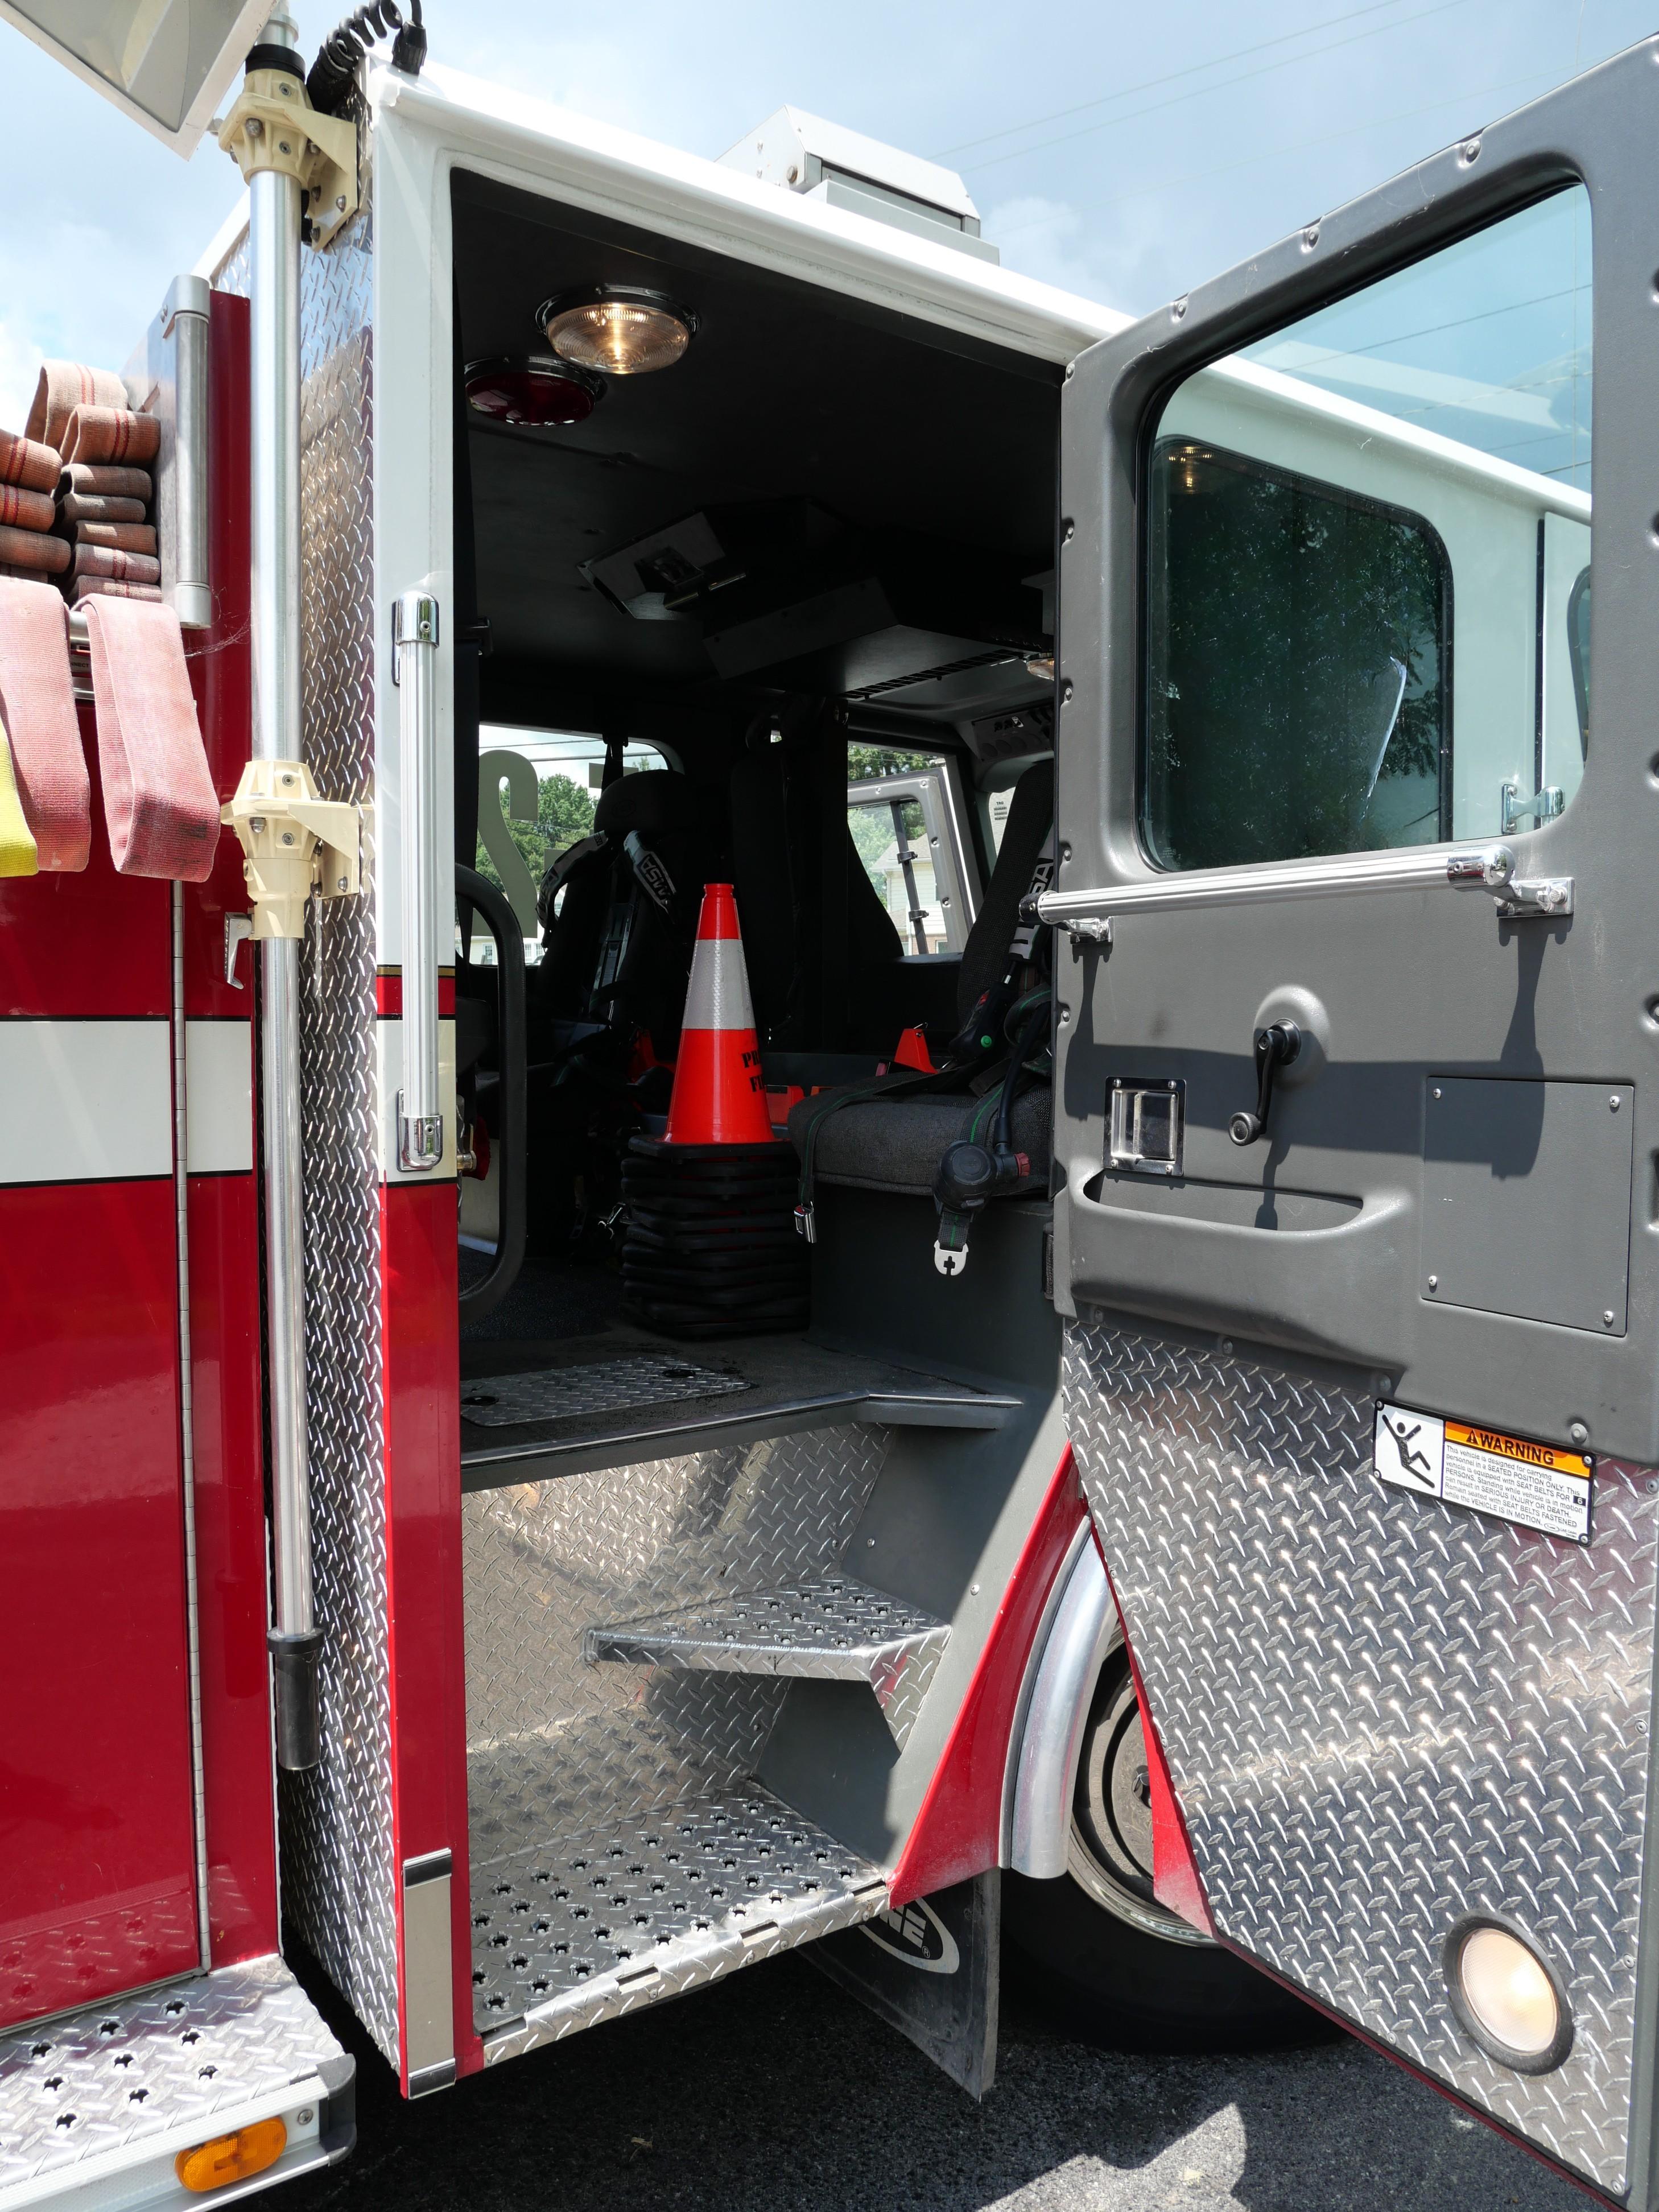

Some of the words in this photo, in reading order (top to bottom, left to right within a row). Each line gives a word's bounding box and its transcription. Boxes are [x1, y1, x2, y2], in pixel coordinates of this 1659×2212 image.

[639, 855, 670, 902] MSA
[742, 1049, 761, 1068] PR
[1459, 1450, 1479, 1459] vehicle
[1488, 1456, 1515, 1469] designed
[1526, 1468, 1551, 1480] carrying
[1480, 1433, 1554, 1465] WARNING
[1446, 1454, 1474, 1466] personnel
[1487, 1464, 1511, 1476] SEATED
[1513, 1472, 1544, 1485] POSITION
[1567, 1487, 1580, 1496] This
[1446, 1460, 1466, 1470] vehicle
[1474, 1468, 1500, 1480] equipped
[1516, 1480, 1532, 1489] SEAT
[1534, 1485, 1554, 1496] BELTS
[1556, 1491, 1570, 1501] FOR
[1457, 1479, 1472, 1488] result
[1481, 1485, 1508, 1499] SERIOUS
[1510, 1494, 1533, 1506] INJURY
[1445, 1490, 1459, 1499] while
[1471, 1497, 1497, 1511] VEHICLE
[1445, 1481, 1466, 1493] Remain
[1468, 1490, 1487, 1500] seated
[1503, 1499, 1518, 1509] SEAT
[1520, 1505, 1540, 1516] BELTS
[1542, 1511, 1577, 1527] FASTENED
[1478, 1476, 1503, 1491] Standing
[1505, 1485, 1520, 1494] while
[1522, 1491, 1544, 1501] vehicle
[1560, 1502, 1582, 1513] motion
[879, 1905, 927, 1949] NE
